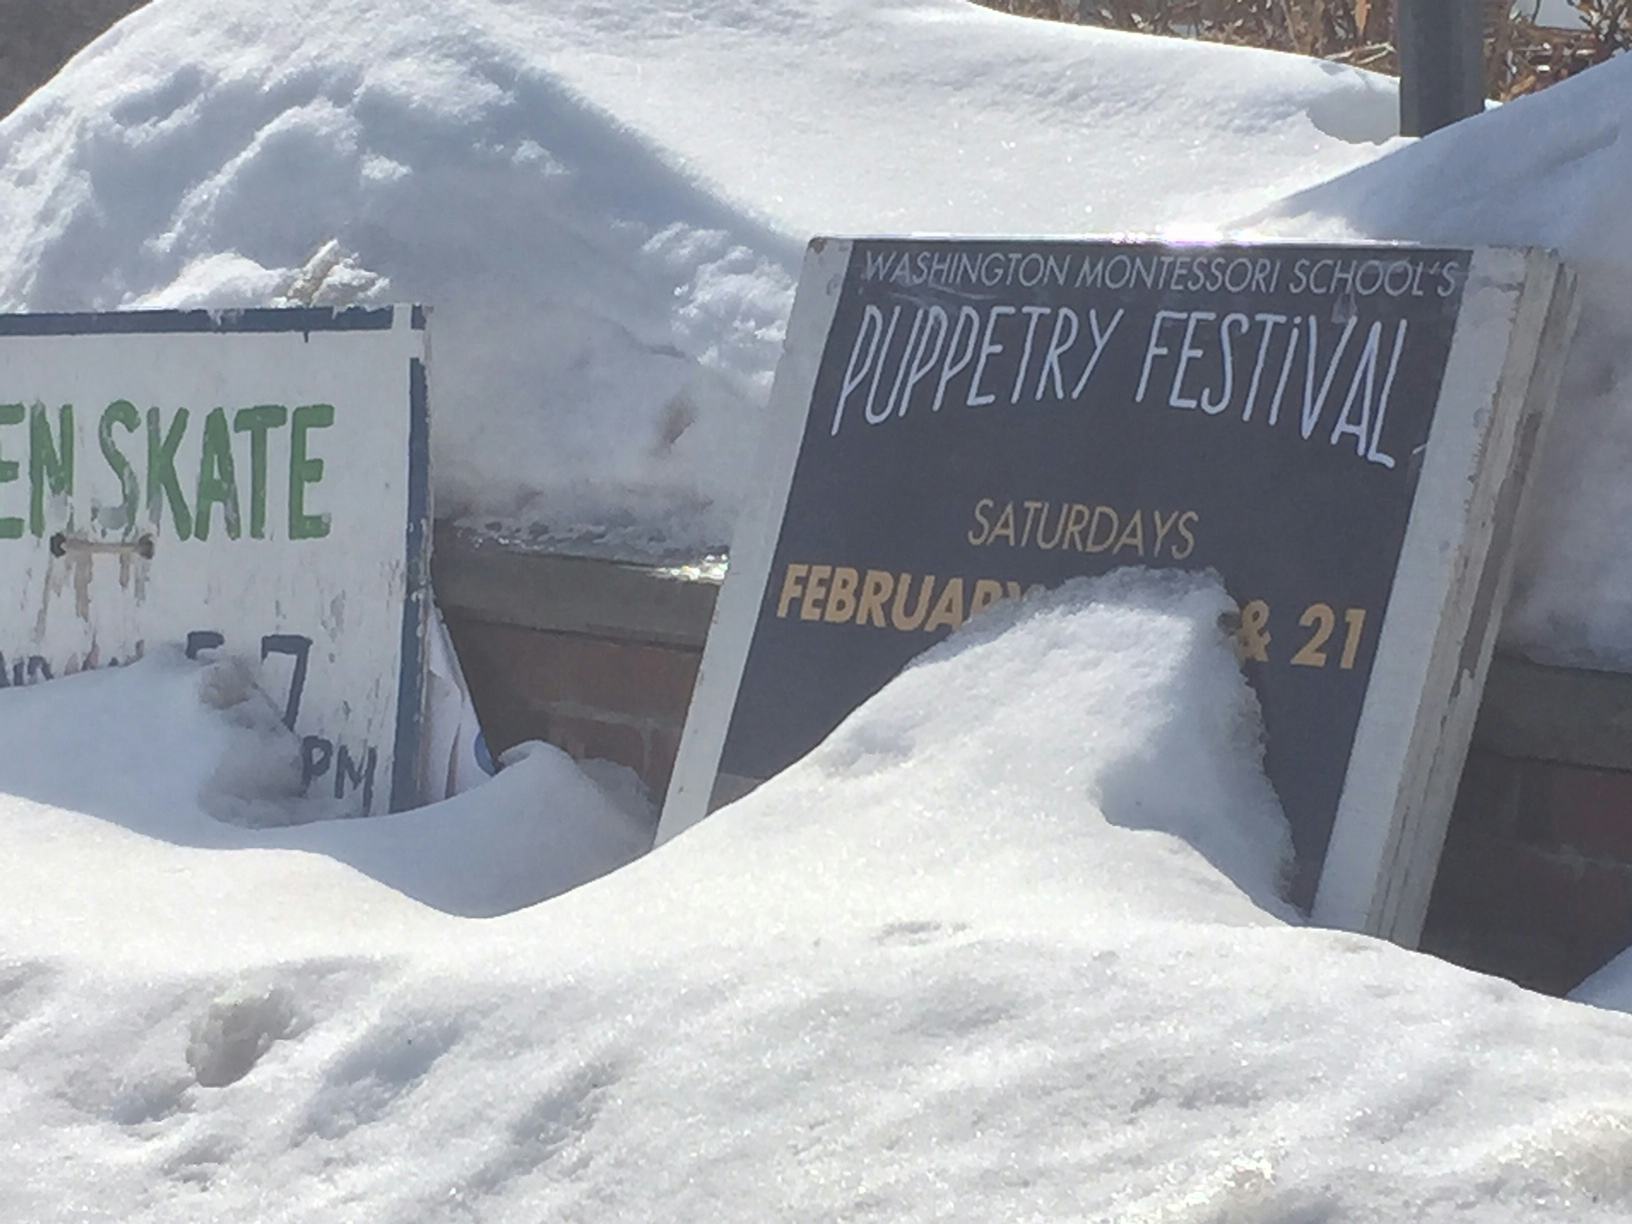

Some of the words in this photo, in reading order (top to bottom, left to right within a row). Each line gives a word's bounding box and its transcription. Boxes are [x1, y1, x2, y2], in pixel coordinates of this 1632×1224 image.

[863, 250, 1073, 288] WASHINGTON
[1075, 253, 1280, 292] MONTESSORI
[1289, 260, 1459, 298] SCHOOL'S
[830, 304, 1124, 437] PUPPETRY
[94, 399, 335, 541] SKATE
[967, 499, 1199, 559] SATURDAYS
[1235, 600, 1272, 663] &
[1290, 603, 1367, 669] 21
[301, 735, 377, 817] PM
